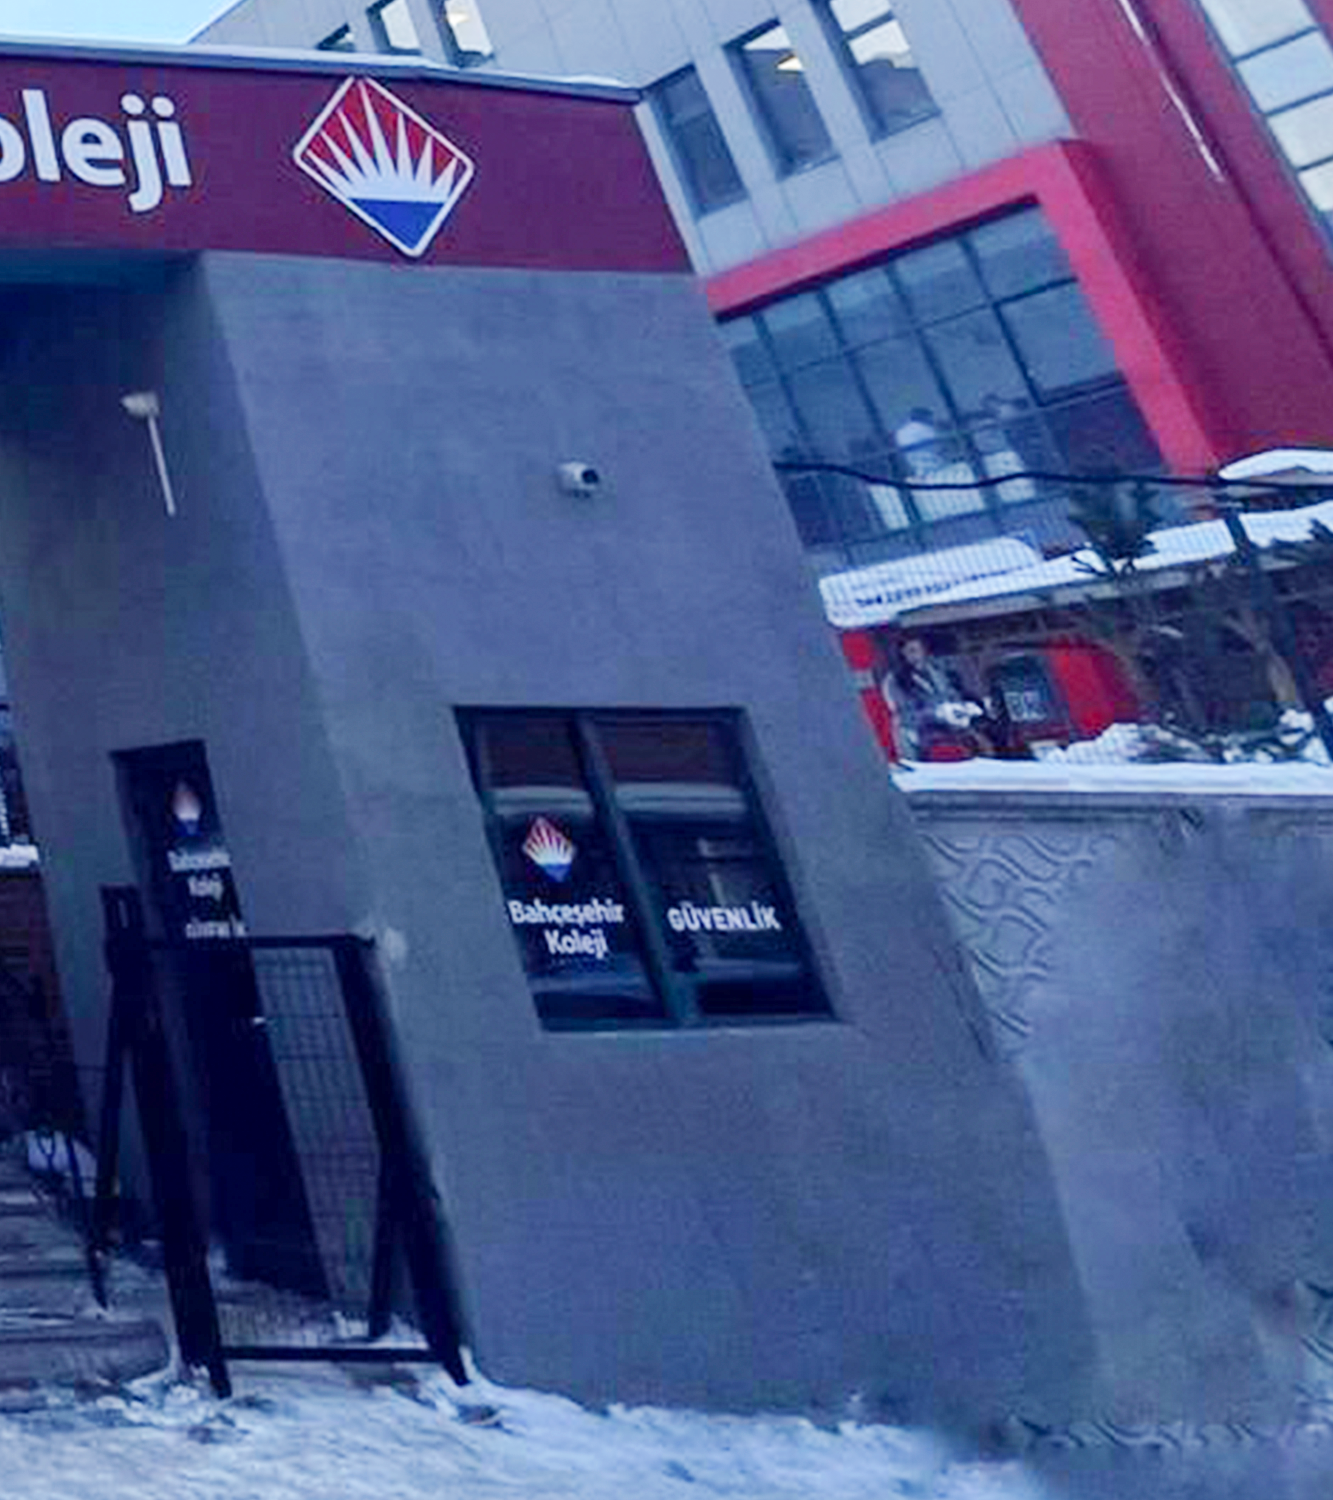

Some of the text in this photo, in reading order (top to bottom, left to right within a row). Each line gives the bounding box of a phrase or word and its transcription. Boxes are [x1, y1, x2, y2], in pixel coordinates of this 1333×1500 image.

[507, 897, 625, 928] Bahçeşehir
[667, 900, 782, 932] GÜVENLİK
[544, 928, 609, 960] Koleji
